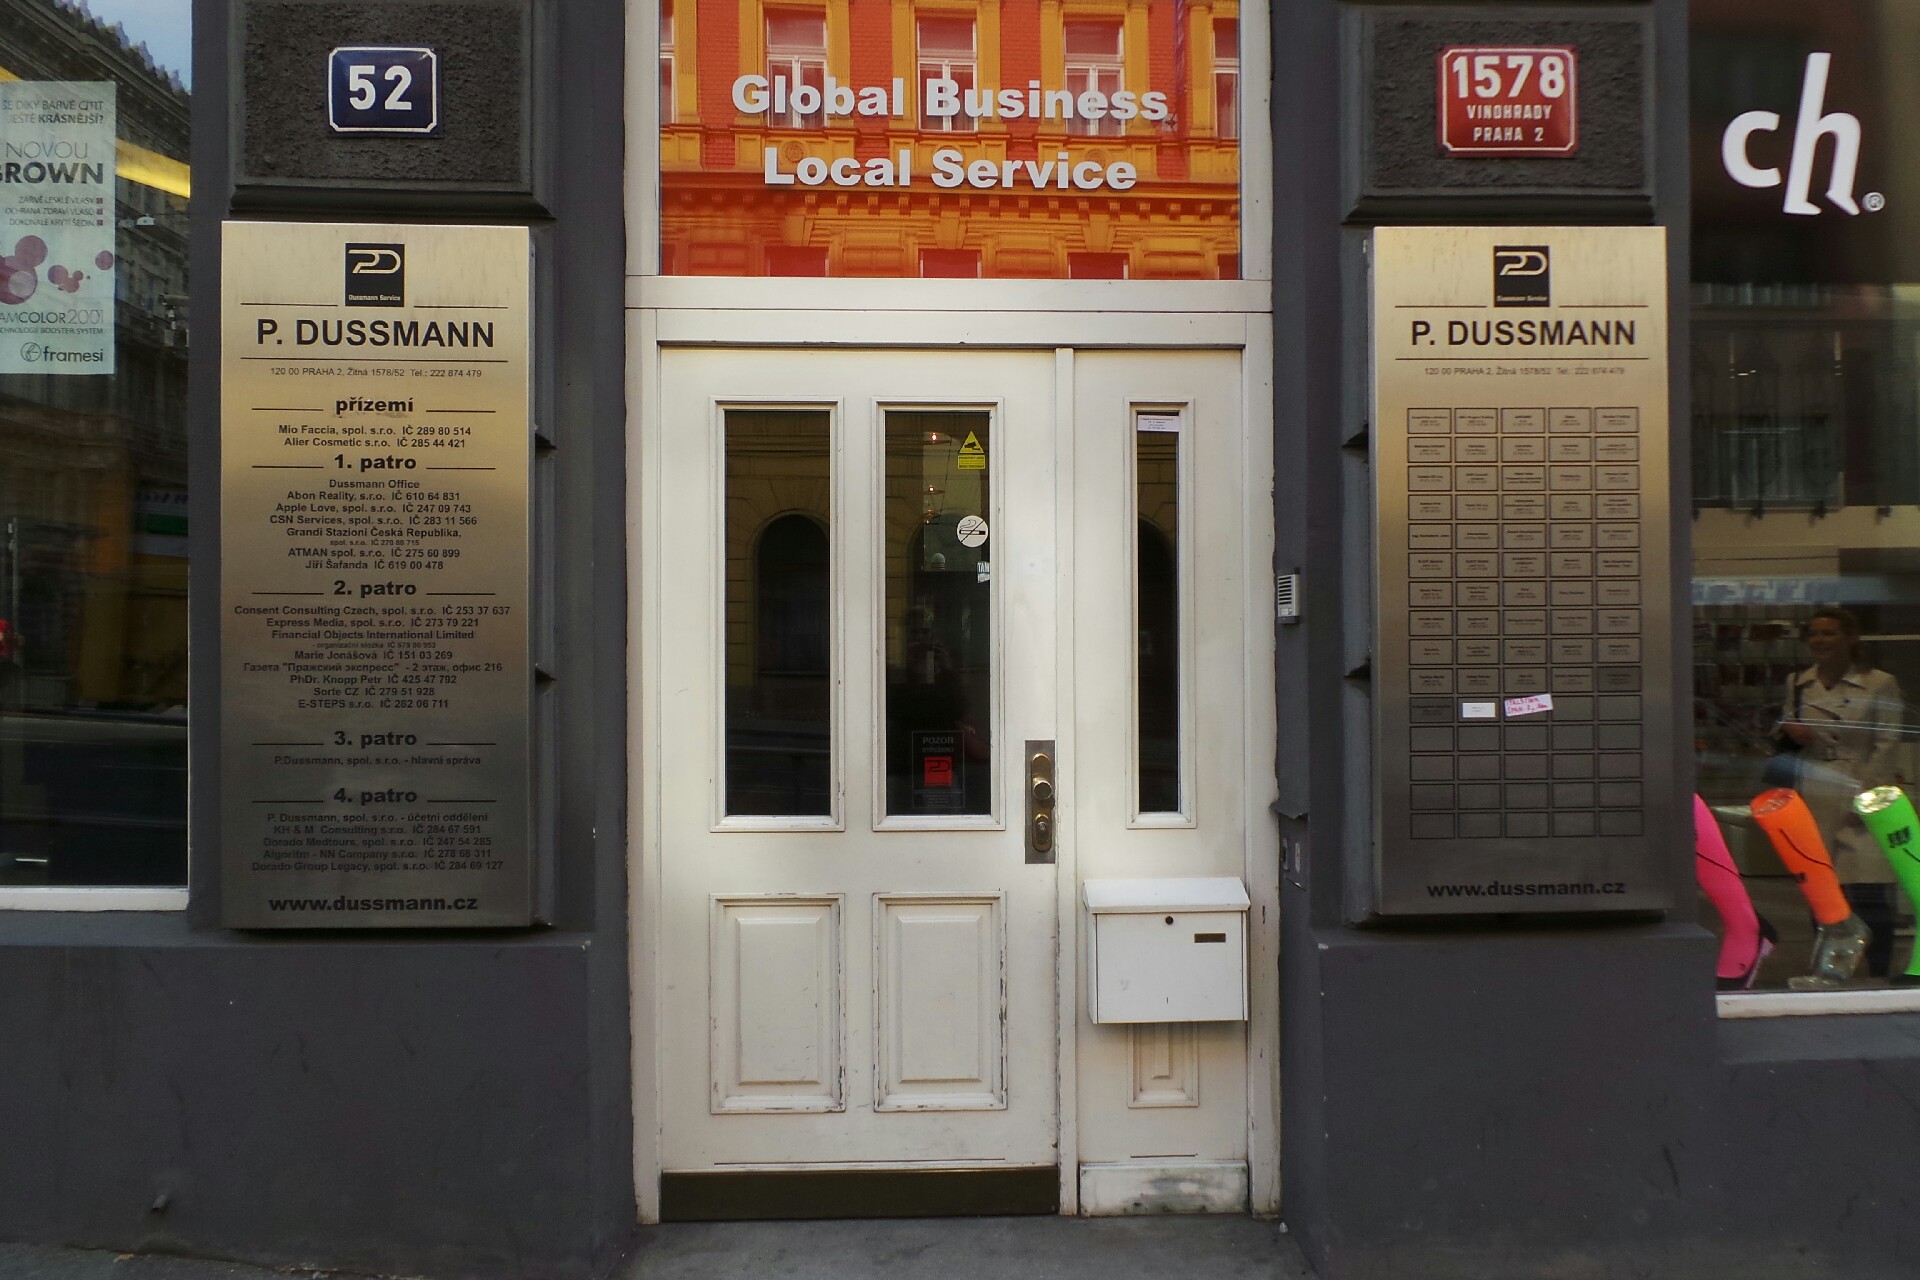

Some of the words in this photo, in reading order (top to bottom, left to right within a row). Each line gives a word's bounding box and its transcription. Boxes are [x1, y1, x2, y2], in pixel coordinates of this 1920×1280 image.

[1452, 56, 1566, 98] 1578
[349, 65, 412, 110] 52
[730, 74, 904, 117] Global
[925, 78, 1169, 121] Business
[1466, 105, 1553, 120] VINOHRADY
[1473, 127, 1523, 142] PRAHA
[1534, 127, 1544, 142] 2
[6, 141, 88, 159] NOVOU
[0, 161, 104, 184] ROWN
[764, 146, 911, 186] Local
[931, 149, 1138, 190] Service
[257, 318, 283, 345] P.
[296, 319, 494, 348] DUSSMANN
[1411, 321, 1435, 346] P.
[1448, 321, 1635, 346] DUSSMANN
[42, 346, 104, 362] framesi
[270, 367, 286, 378] 120
[288, 367, 300, 378] 00
[303, 367, 335, 378] PRAHA
[347, 367, 368, 378] Žitná
[371, 367, 405, 378] 1578/52
[430, 367, 446, 378] 222
[448, 367, 463, 378] 874
[466, 367, 482, 378] 479
[335, 397, 414, 415] přízemí
[278, 425, 298, 433] Mio
[301, 425, 339, 434] Faccia,
[341, 427, 367, 436] spol.
[402, 425, 414, 436] IČ
[416, 427, 435, 435] 289
[438, 427, 450, 435] 80
[453, 427, 471, 435] 514
[312, 438, 362, 446] Cosmetic
[397, 437, 408, 447] IČ
[411, 439, 430, 447] 285
[433, 439, 446, 447] 44
[448, 439, 465, 448] 421
[334, 454, 352, 468] 1.
[360, 456, 417, 472] patro
[329, 480, 385, 488] Dussmann
[388, 480, 420, 489] Office
[287, 491, 317, 499] Abon
[405, 492, 425, 501] 610
[275, 503, 308, 514] Apple
[310, 504, 339, 512] Love,
[341, 502, 367, 514] spol.
[416, 505, 436, 514] 247
[438, 505, 451, 513] 09
[453, 505, 471, 513] 743
[270, 514, 294, 523] CSN
[297, 515, 345, 525] Services,
[348, 514, 375, 526] spol.
[423, 514, 442, 525] 283
[445, 514, 457, 525] 11
[459, 514, 478, 525] 566
[286, 528, 323, 536] Grandi
[325, 527, 367, 536] Stazioni
[370, 527, 403, 539] Česká
[406, 527, 462, 538] Republika,
[325, 559, 368, 569] Šafanda
[388, 561, 407, 569] 619
[410, 561, 423, 569] 00
[425, 561, 444, 569] 478
[333, 580, 352, 595] 2.
[360, 582, 417, 598] patro
[271, 629, 321, 638] Financial
[323, 630, 363, 640] Objects
[366, 631, 433, 639] International
[436, 630, 474, 639] Limited
[334, 731, 352, 745] 3.
[360, 732, 418, 749] patro
[333, 788, 352, 803] 4.
[360, 789, 418, 806] patro
[1427, 881, 1626, 897] www.dussmann.cz
[269, 895, 478, 911] www.dussmann.cz
